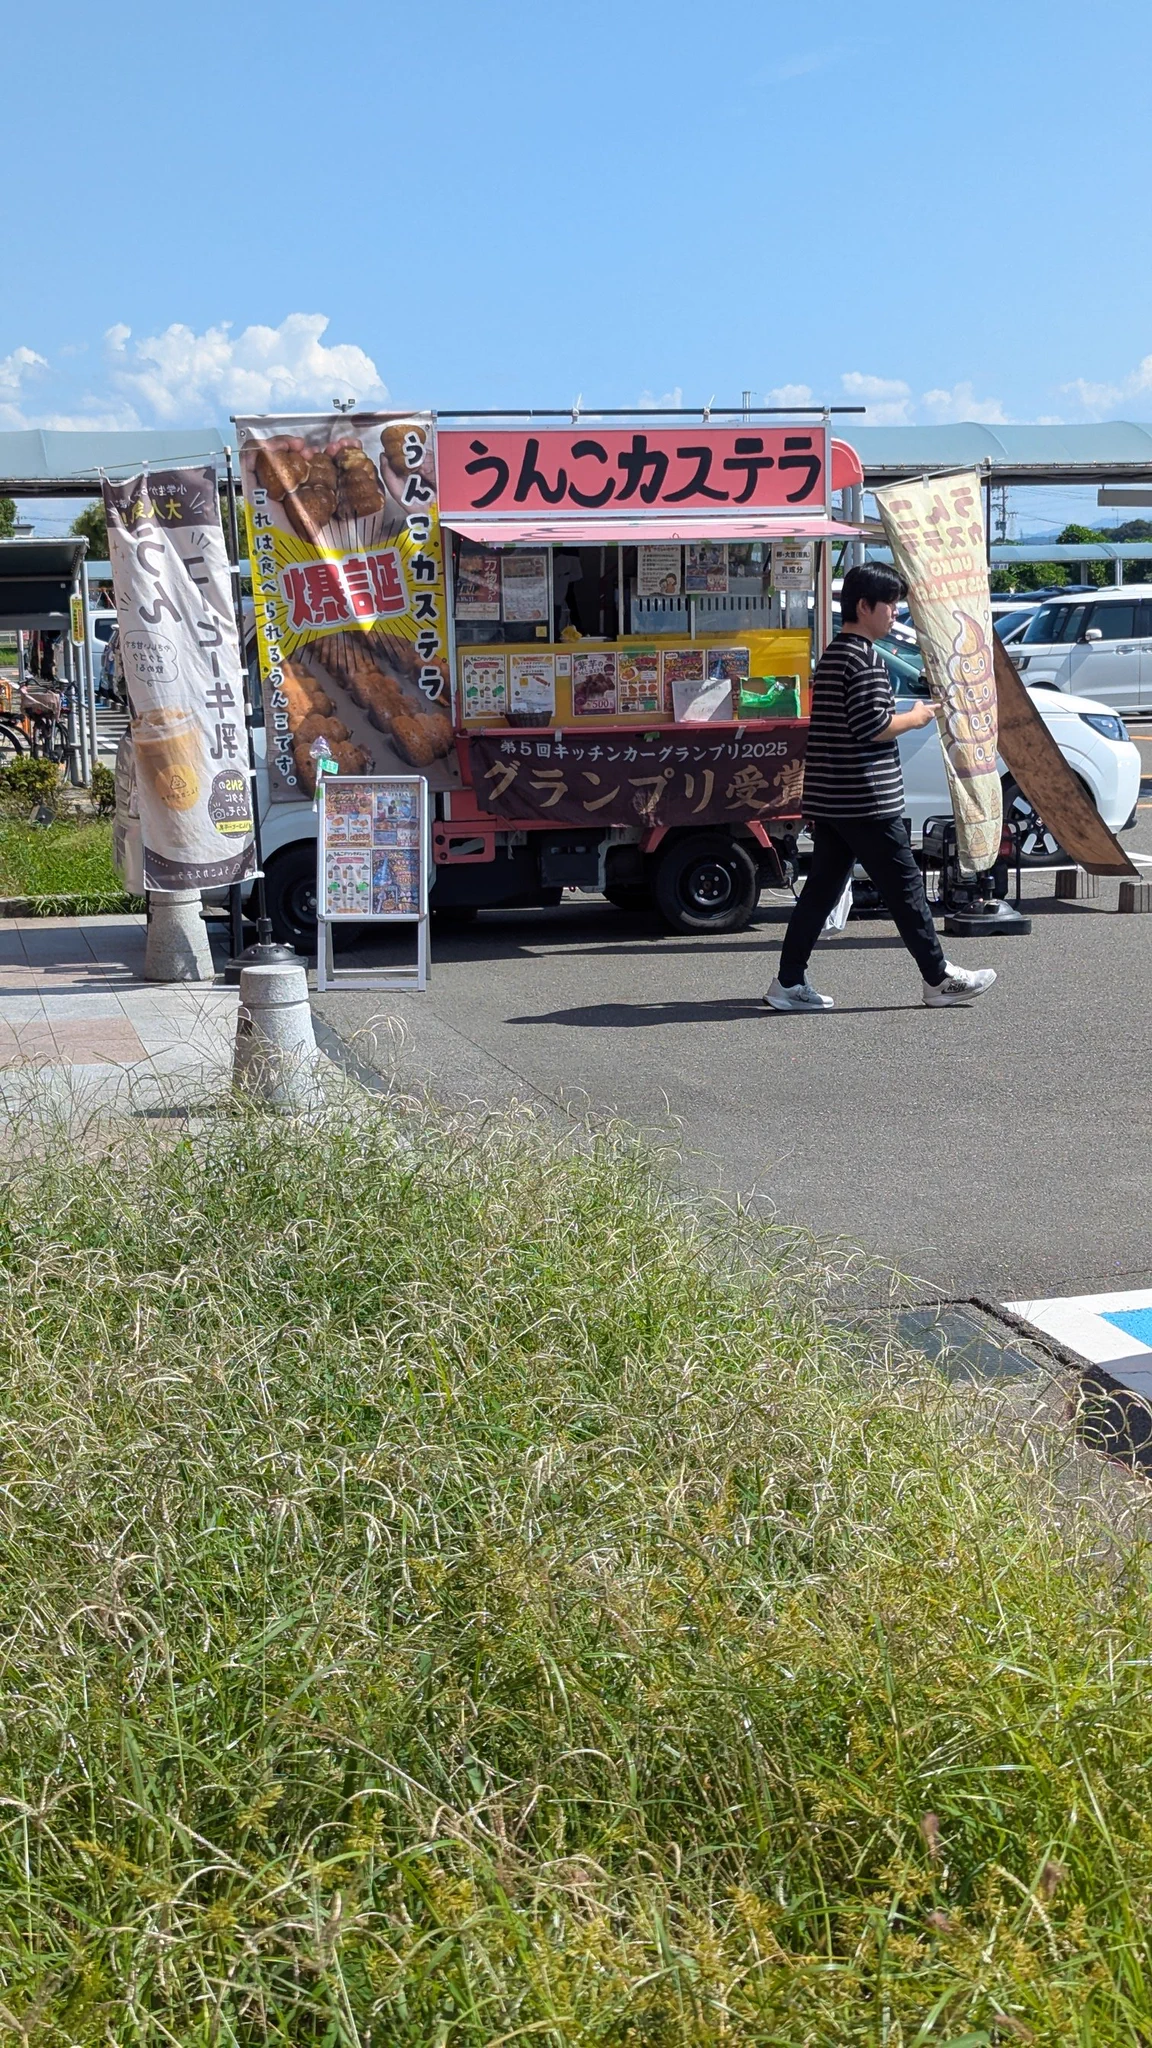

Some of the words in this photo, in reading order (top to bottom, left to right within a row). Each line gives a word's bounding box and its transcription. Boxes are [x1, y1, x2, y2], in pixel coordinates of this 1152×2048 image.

[465, 434, 821, 508] うんこカステラ
[283, 552, 405, 628] 爆誕
[403, 433, 444, 700] うんこカステラ
[252, 488, 297, 786] これは食べられるうんこです。
[484, 758, 806, 814] グランプリ受賞
[500, 739, 788, 763] 第5回キッチンカーグランプリ2025
